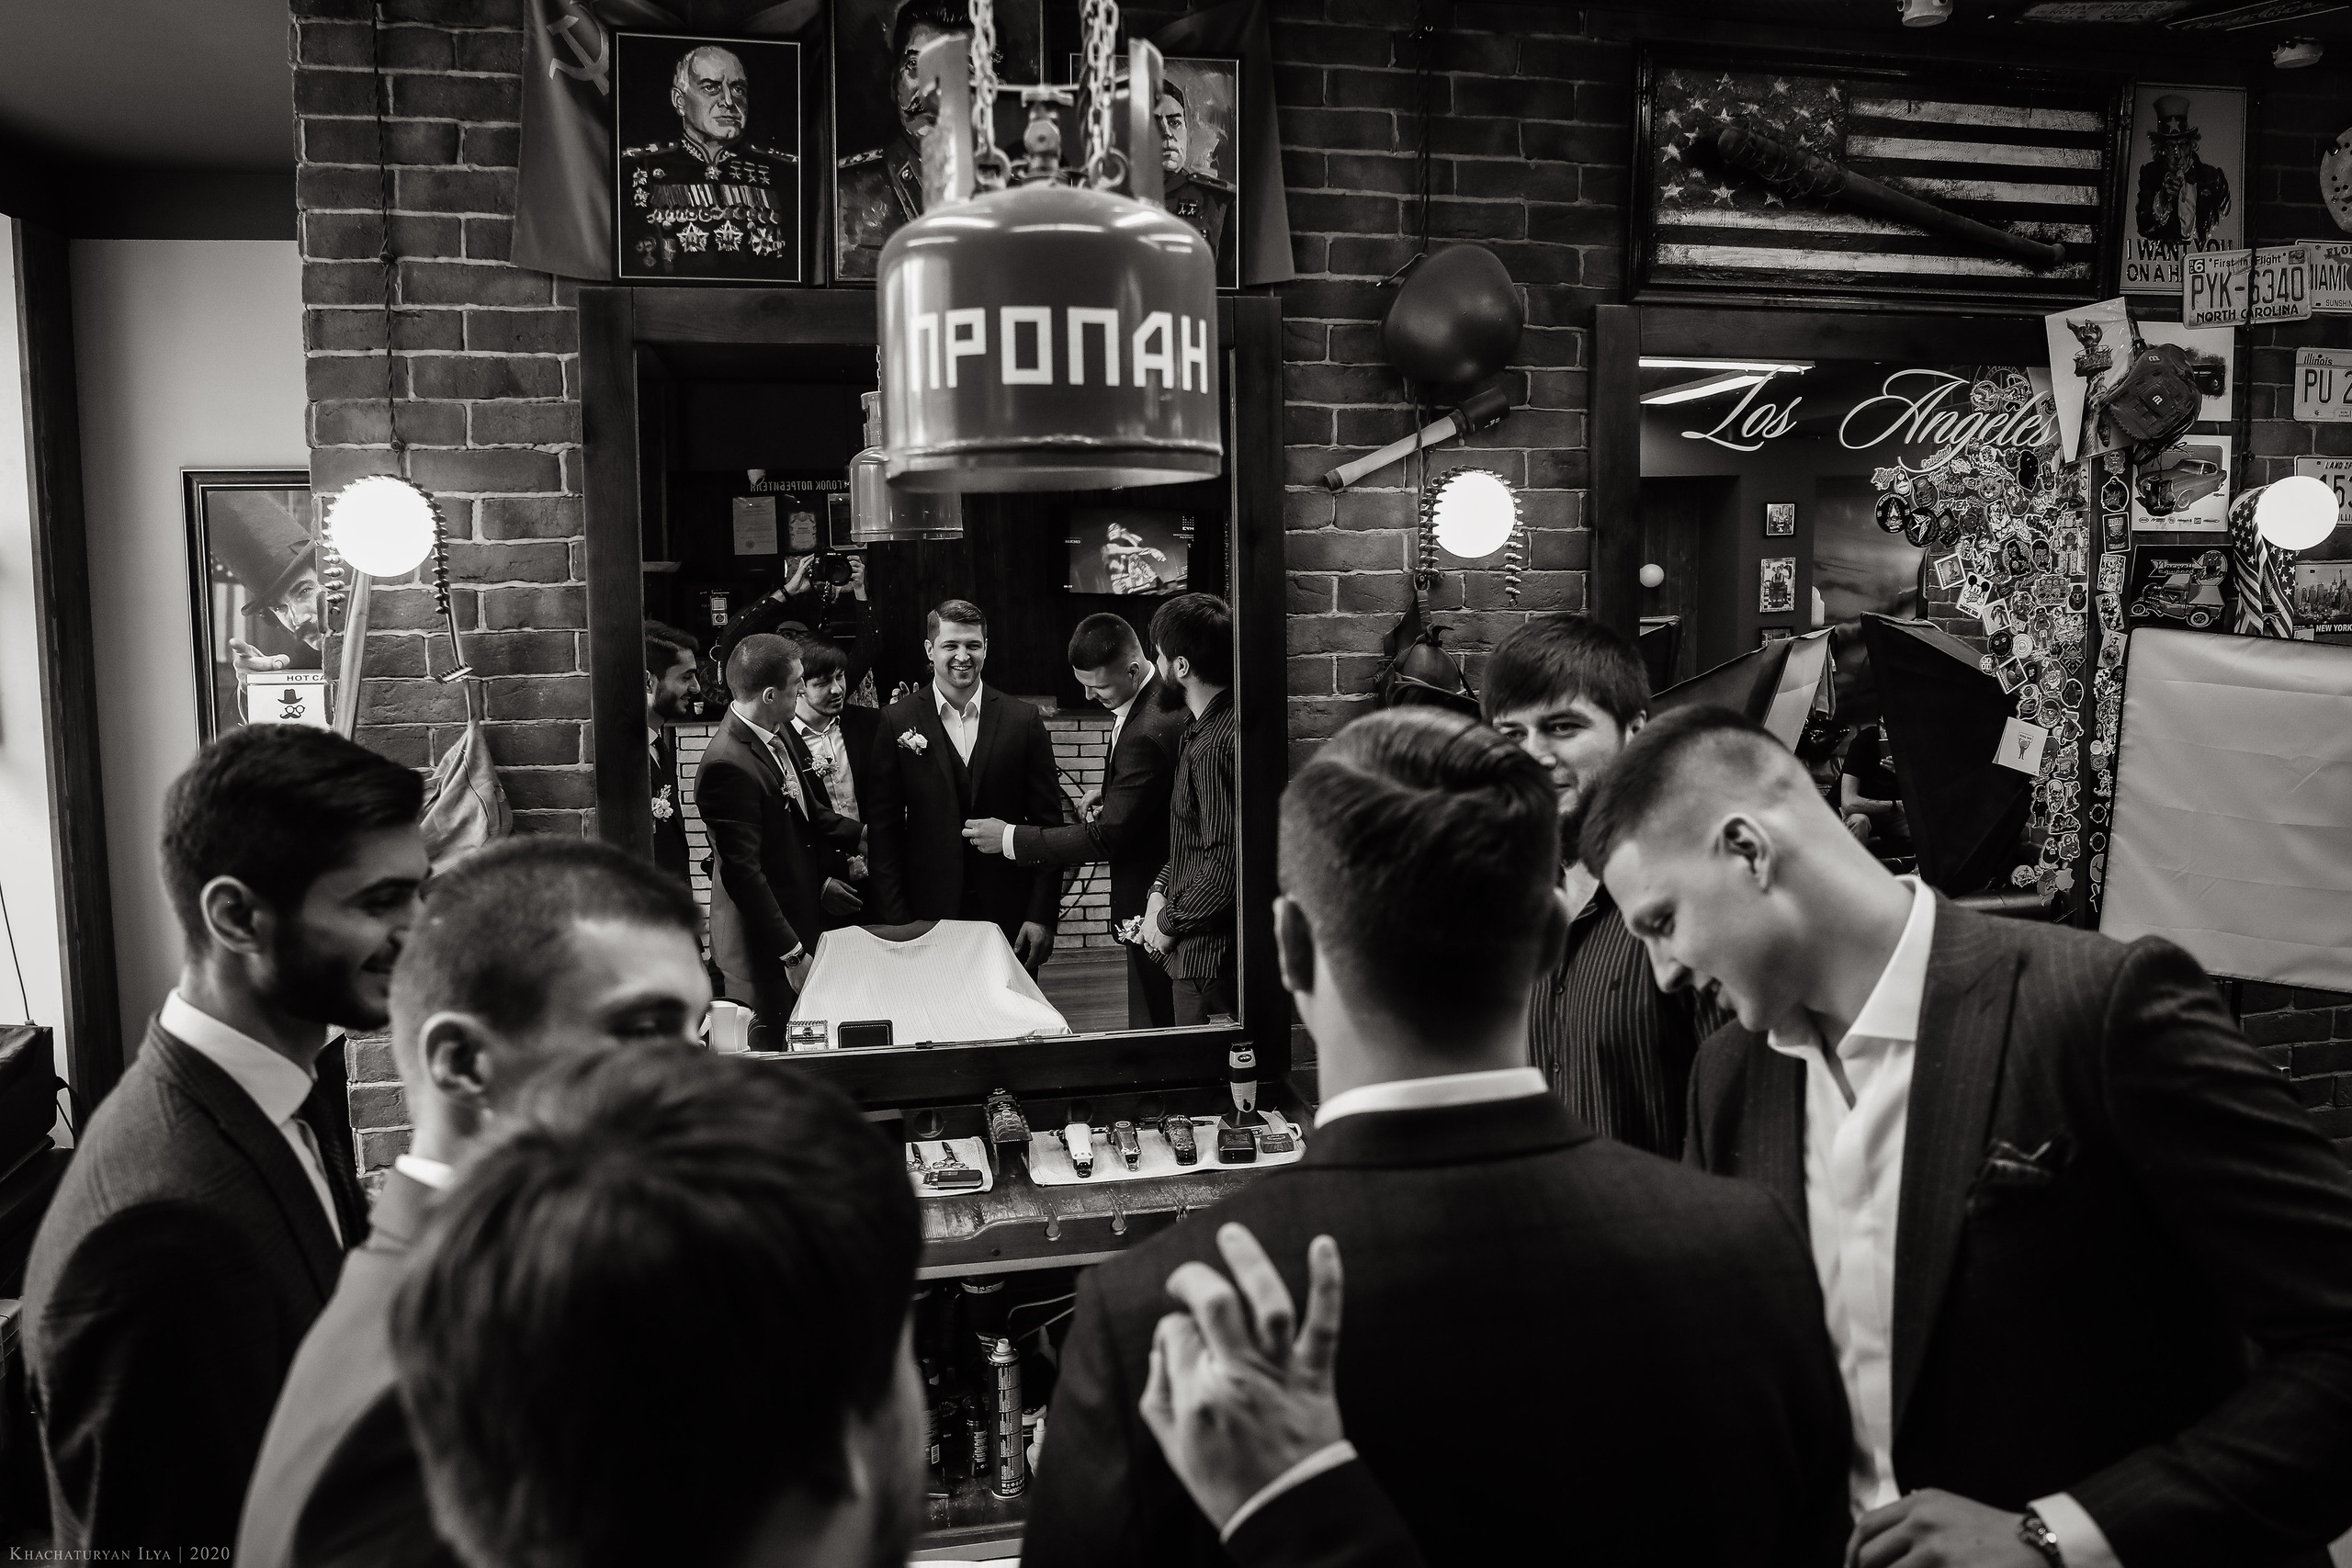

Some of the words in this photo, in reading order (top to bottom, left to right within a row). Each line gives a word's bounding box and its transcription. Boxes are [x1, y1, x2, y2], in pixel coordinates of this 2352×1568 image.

[2126, 239, 2132, 261] I
[2136, 239, 2191, 261] WANT
[2213, 257, 2234, 268] First
[2240, 254, 2248, 266] in
[2126, 264, 2150, 282] ON
[2154, 265, 2165, 282] A
[2169, 265, 2182, 282] H
[2197, 309, 2236, 322] NORTH
[910, 306, 1208, 394] ПРОПАН
[2304, 353, 2333, 366] Illinois
[2304, 369, 2332, 403] PU
[1680, 365, 1804, 451] Los
[1838, 368, 2060, 472] Angeles
[2315, 624, 2333, 633] NEW
[2333, 624, 2352, 632] YORK
